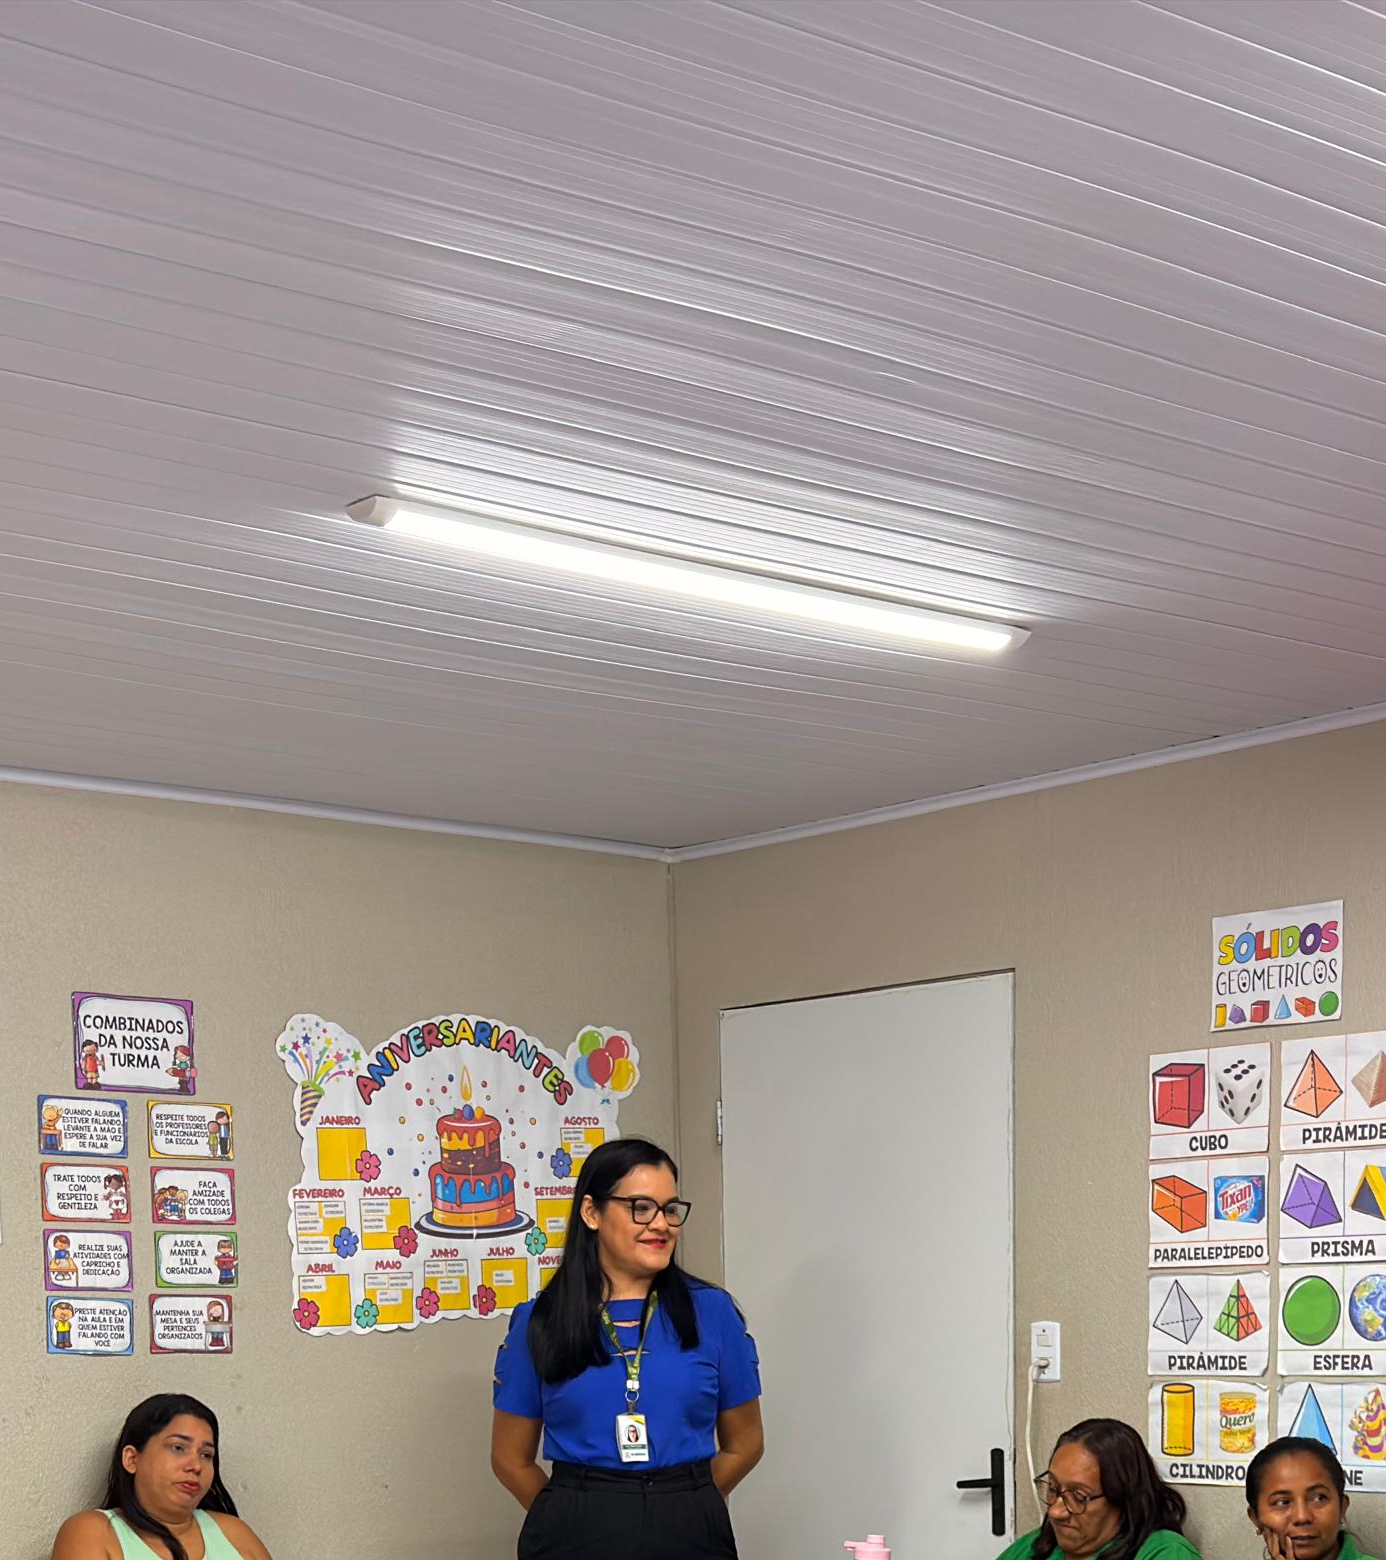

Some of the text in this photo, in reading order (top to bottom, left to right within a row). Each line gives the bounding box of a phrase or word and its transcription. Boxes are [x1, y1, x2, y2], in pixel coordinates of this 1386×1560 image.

[1217, 920, 1339, 966] SÓLIDOS
[1216, 958, 1339, 996] GEOMETRICOS
[83, 1014, 184, 1035] COMBINADOS
[98, 1033, 171, 1052] DA NOSSA
[110, 1052, 161, 1070] TURMA
[356, 1018, 574, 1105] ANIVERSARIANTES
[319, 1115, 361, 1126] JANEIRO
[564, 1116, 600, 1126] AGOSTO
[1188, 1133, 1230, 1152] CUBO
[53, 1174, 101, 1184] TRATE TODOS
[68, 1184, 87, 1192] COM
[192, 1189, 225, 1198] AMIZADE
[293, 1188, 345, 1199] FEVEREIRO
[363, 1186, 402, 1198] MARÇO
[56, 1193, 92, 1201] RESPEITO
[188, 1198, 230, 1207] COM TODOS
[58, 1202, 98, 1211] GENTILEZA
[188, 1207, 231, 1216] OS COLEGAS
[173, 1240, 203, 1248] AJUDE A
[1311, 1239, 1376, 1258] PRISMA
[170, 1249, 207, 1257] MANTER A
[430, 1248, 459, 1259] JUNHO
[487, 1246, 515, 1257] JULHO
[1154, 1243, 1264, 1262] PARALELEPÍPEDO
[179, 1258, 197, 1266] SALA
[375, 1260, 402, 1270] MAIO
[165, 1266, 213, 1275] ORGANIZADA
[307, 1263, 335, 1274] ABRIL
[1167, 1352, 1248, 1372] PIRÂMIDE
[1312, 1353, 1374, 1372] ESFERA
[1219, 1412, 1255, 1430] Quero
[1169, 1462, 1247, 1482] CILINDRO
